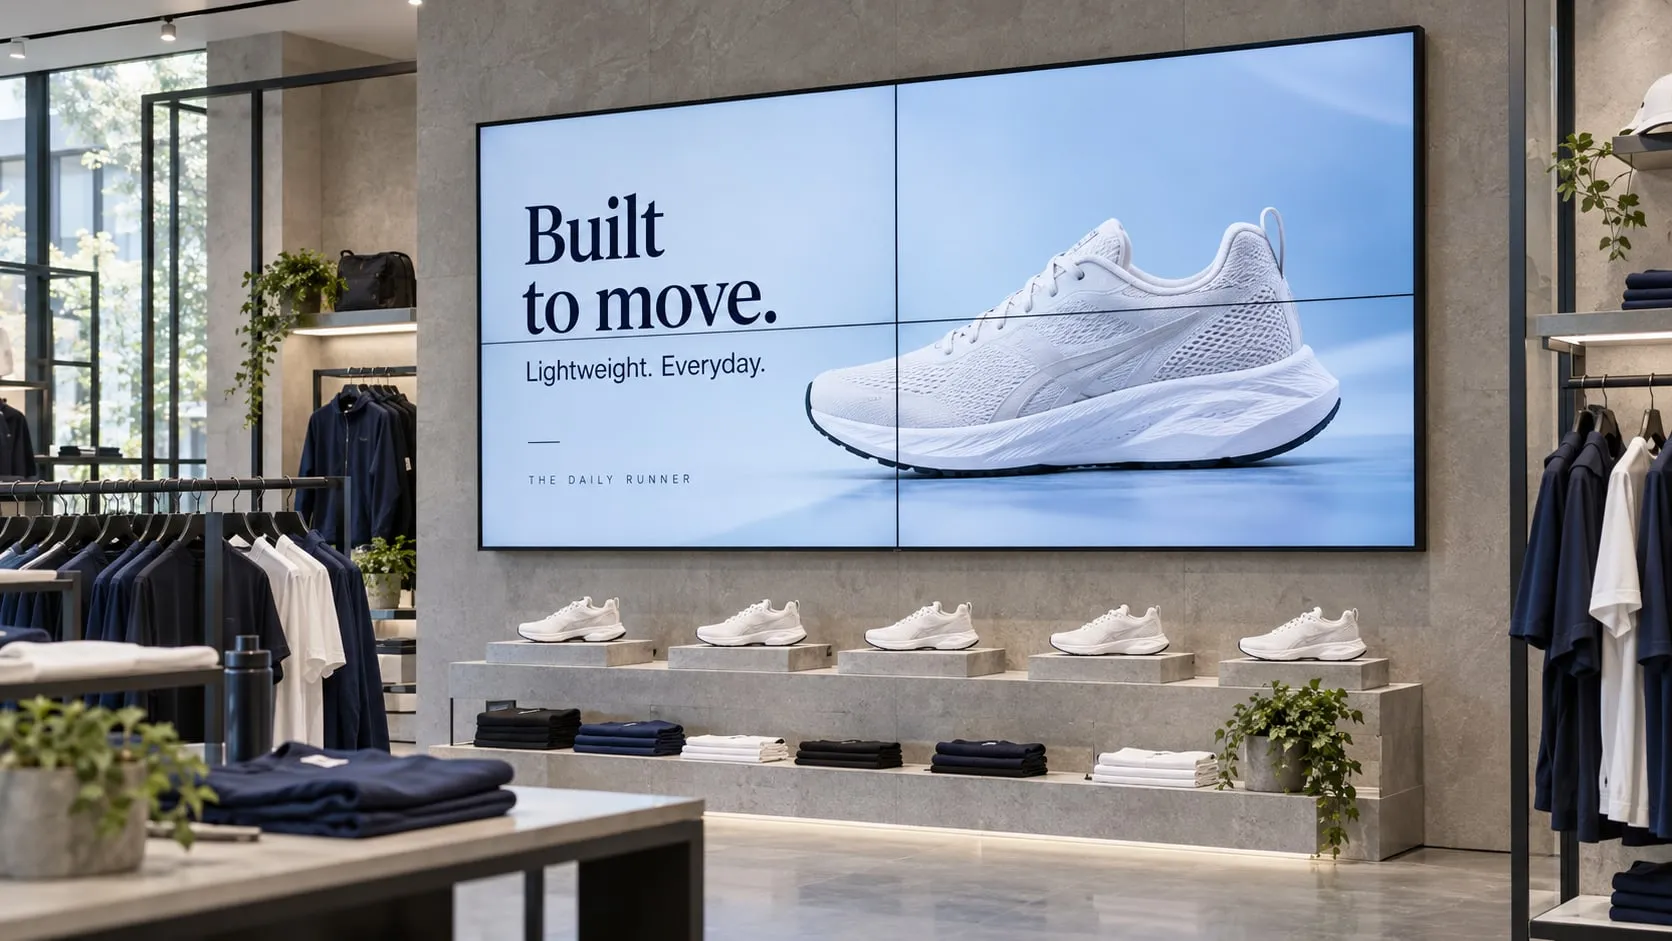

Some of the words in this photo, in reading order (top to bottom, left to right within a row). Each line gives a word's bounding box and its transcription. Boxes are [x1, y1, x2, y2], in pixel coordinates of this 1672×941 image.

[525, 192, 666, 266] Built
[522, 281, 580, 335] to
[596, 280, 777, 331] move.
[527, 355, 653, 387] Lightweight.
[662, 352, 766, 381] Everyday.
[529, 474, 557, 485] THE
[568, 474, 614, 485] DAILY
[626, 473, 691, 485] RUNNER
